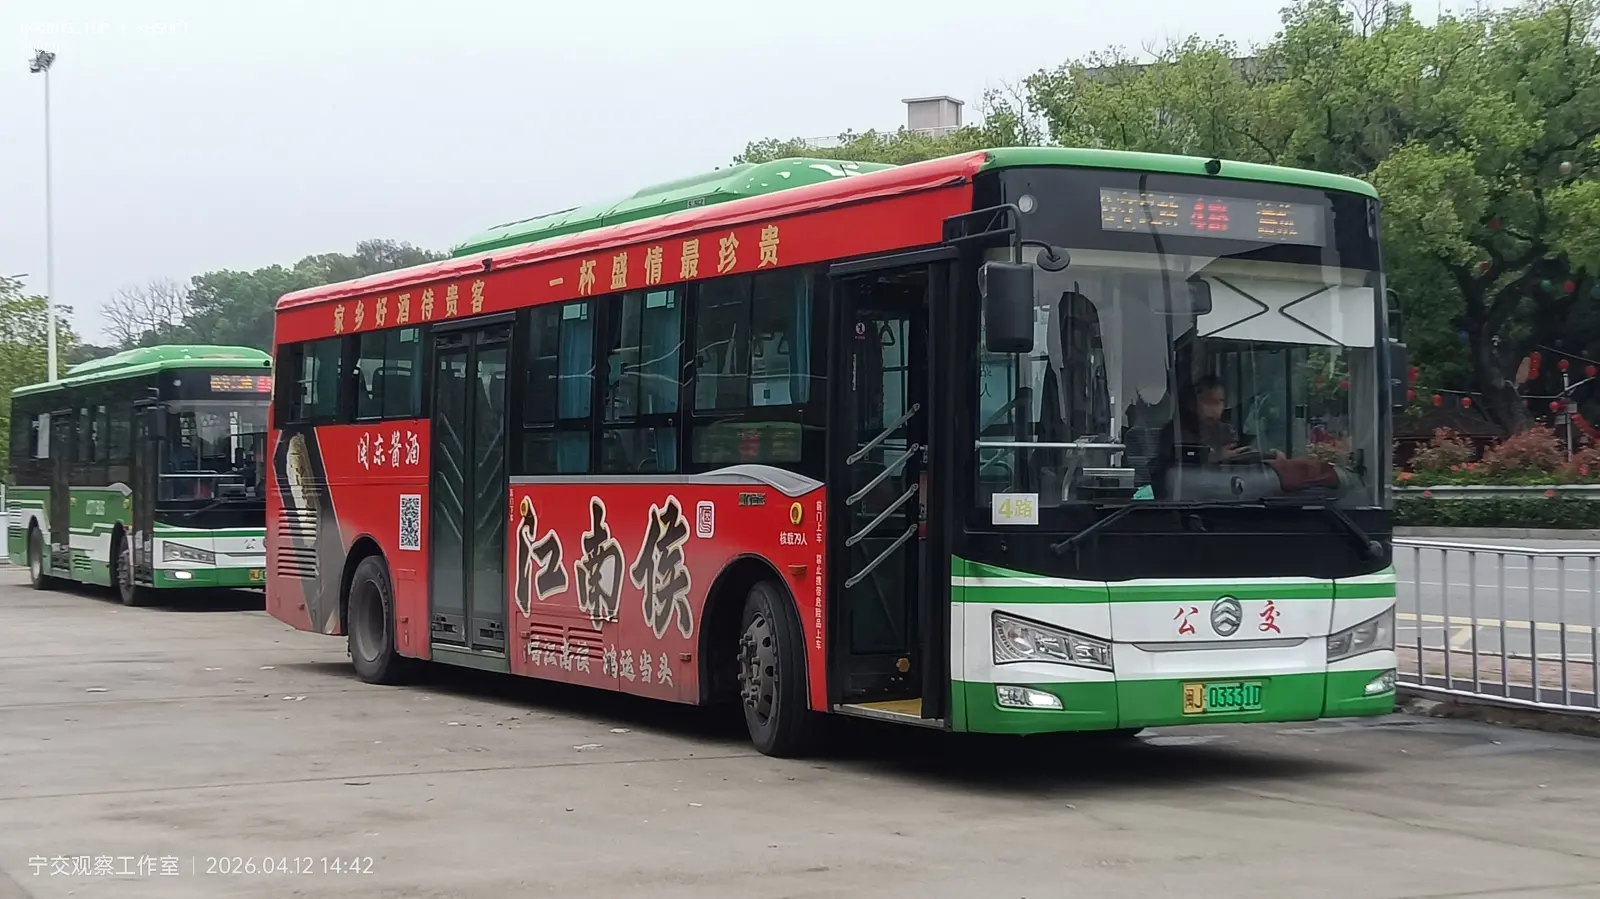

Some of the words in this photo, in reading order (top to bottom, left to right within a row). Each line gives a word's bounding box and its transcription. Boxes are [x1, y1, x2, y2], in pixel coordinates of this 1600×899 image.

[333, 279, 486, 335] 家乡好酒待贵客
[549, 224, 780, 296] 一杯盛情最珍贵
[357, 430, 420, 471] 闽东酱酒
[997, 498, 1033, 519] 4路
[514, 494, 694, 640] 江南侯
[1173, 606, 1199, 635] 公
[1258, 600, 1281, 633] 交
[602, 643, 674, 688] 鸿运当头
